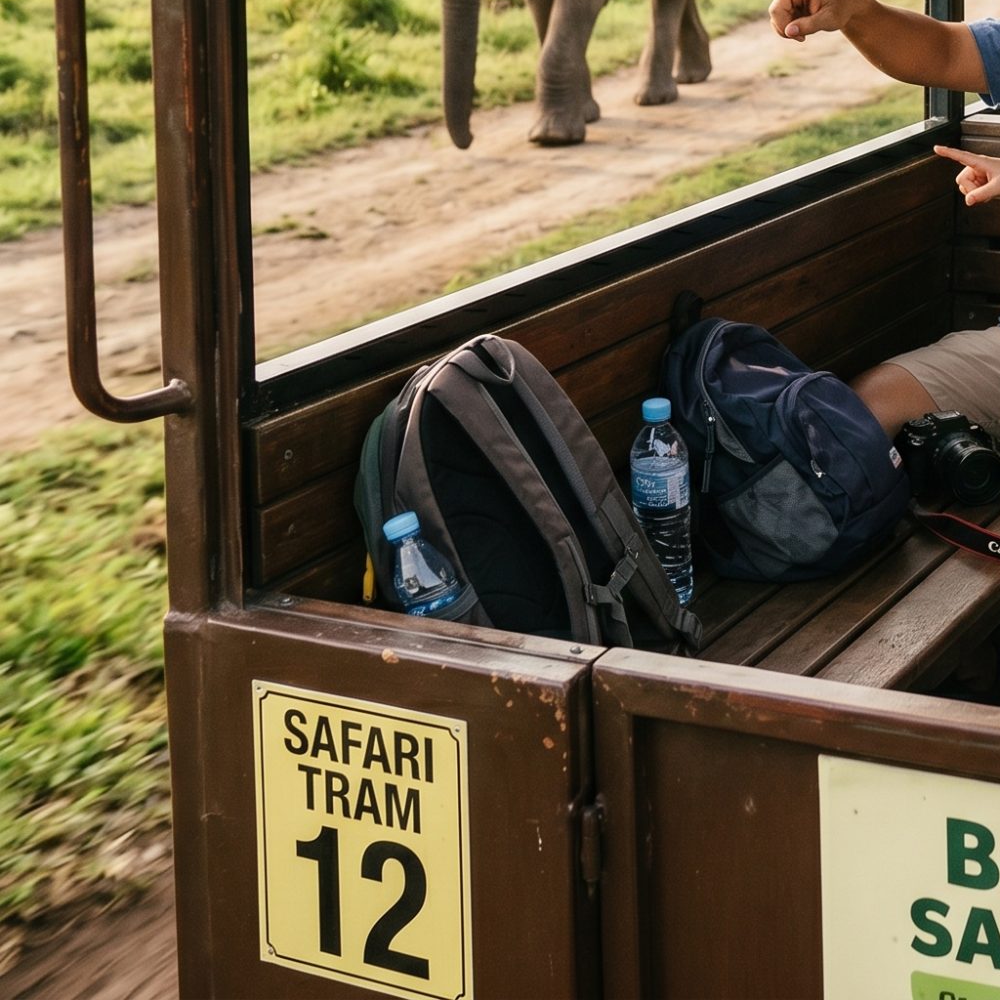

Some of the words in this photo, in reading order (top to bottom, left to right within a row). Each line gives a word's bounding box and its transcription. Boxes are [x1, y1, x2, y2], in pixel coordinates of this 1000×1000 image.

[283, 708, 434, 784] SAFARI
[297, 763, 422, 835] TRAM
[295, 825, 430, 981] 12
